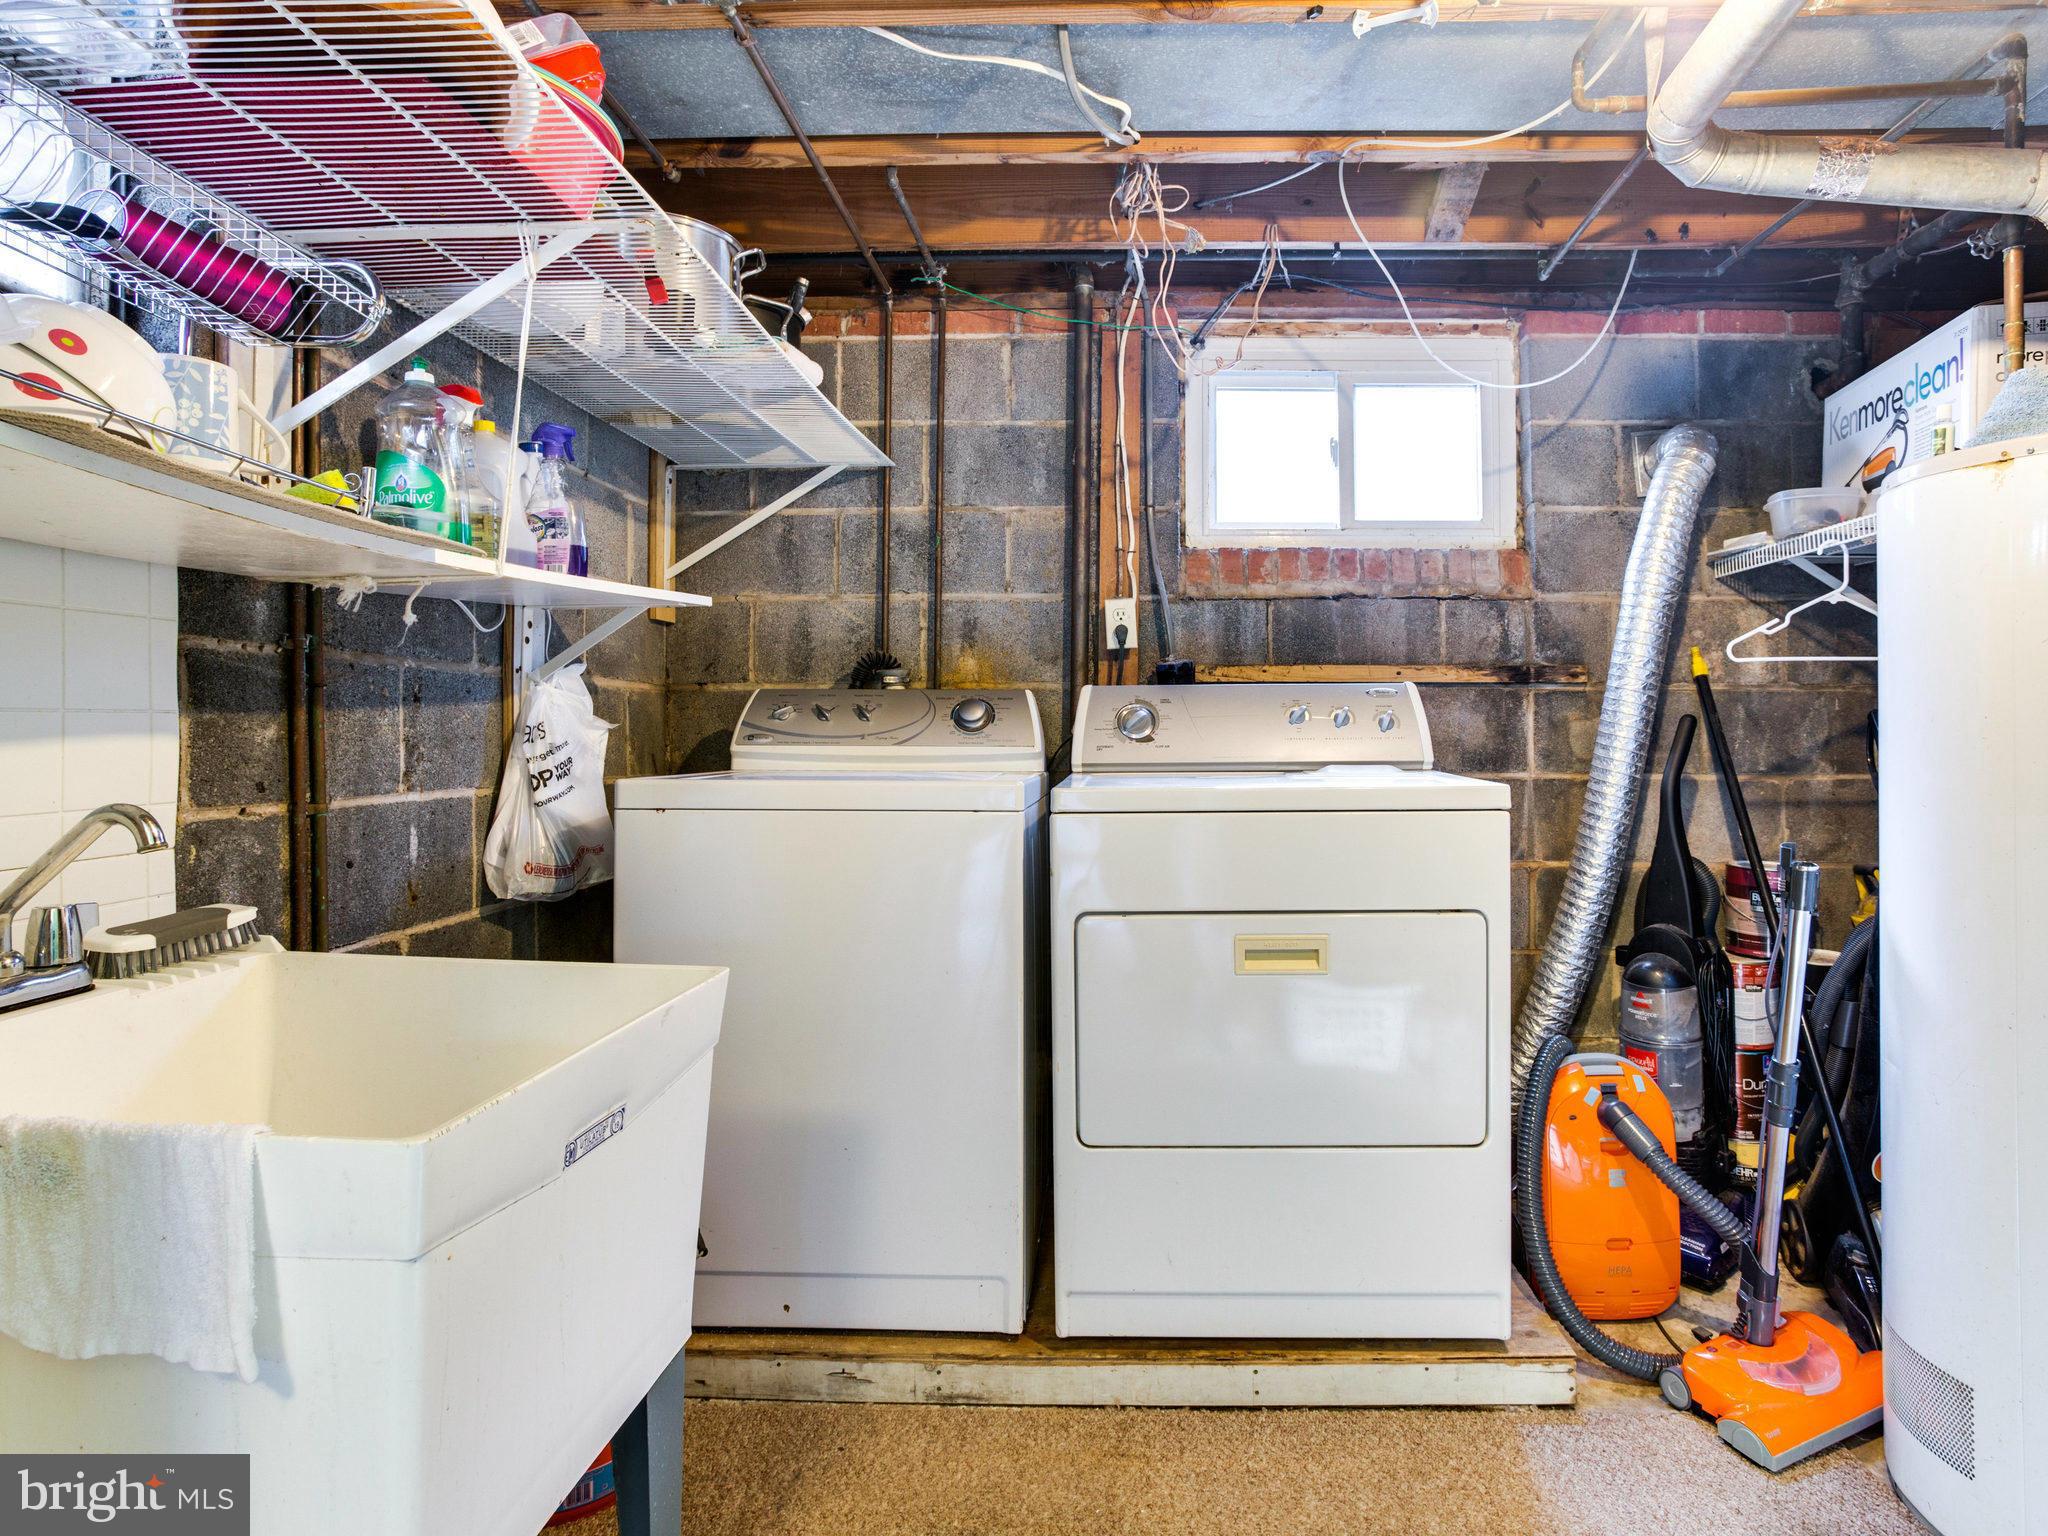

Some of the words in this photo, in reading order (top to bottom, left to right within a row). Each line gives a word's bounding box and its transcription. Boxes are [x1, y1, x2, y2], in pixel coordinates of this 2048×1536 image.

[379, 488, 434, 506] Palmolive
[554, 756, 574, 773] YOUR
[555, 766, 572, 782] WAY
